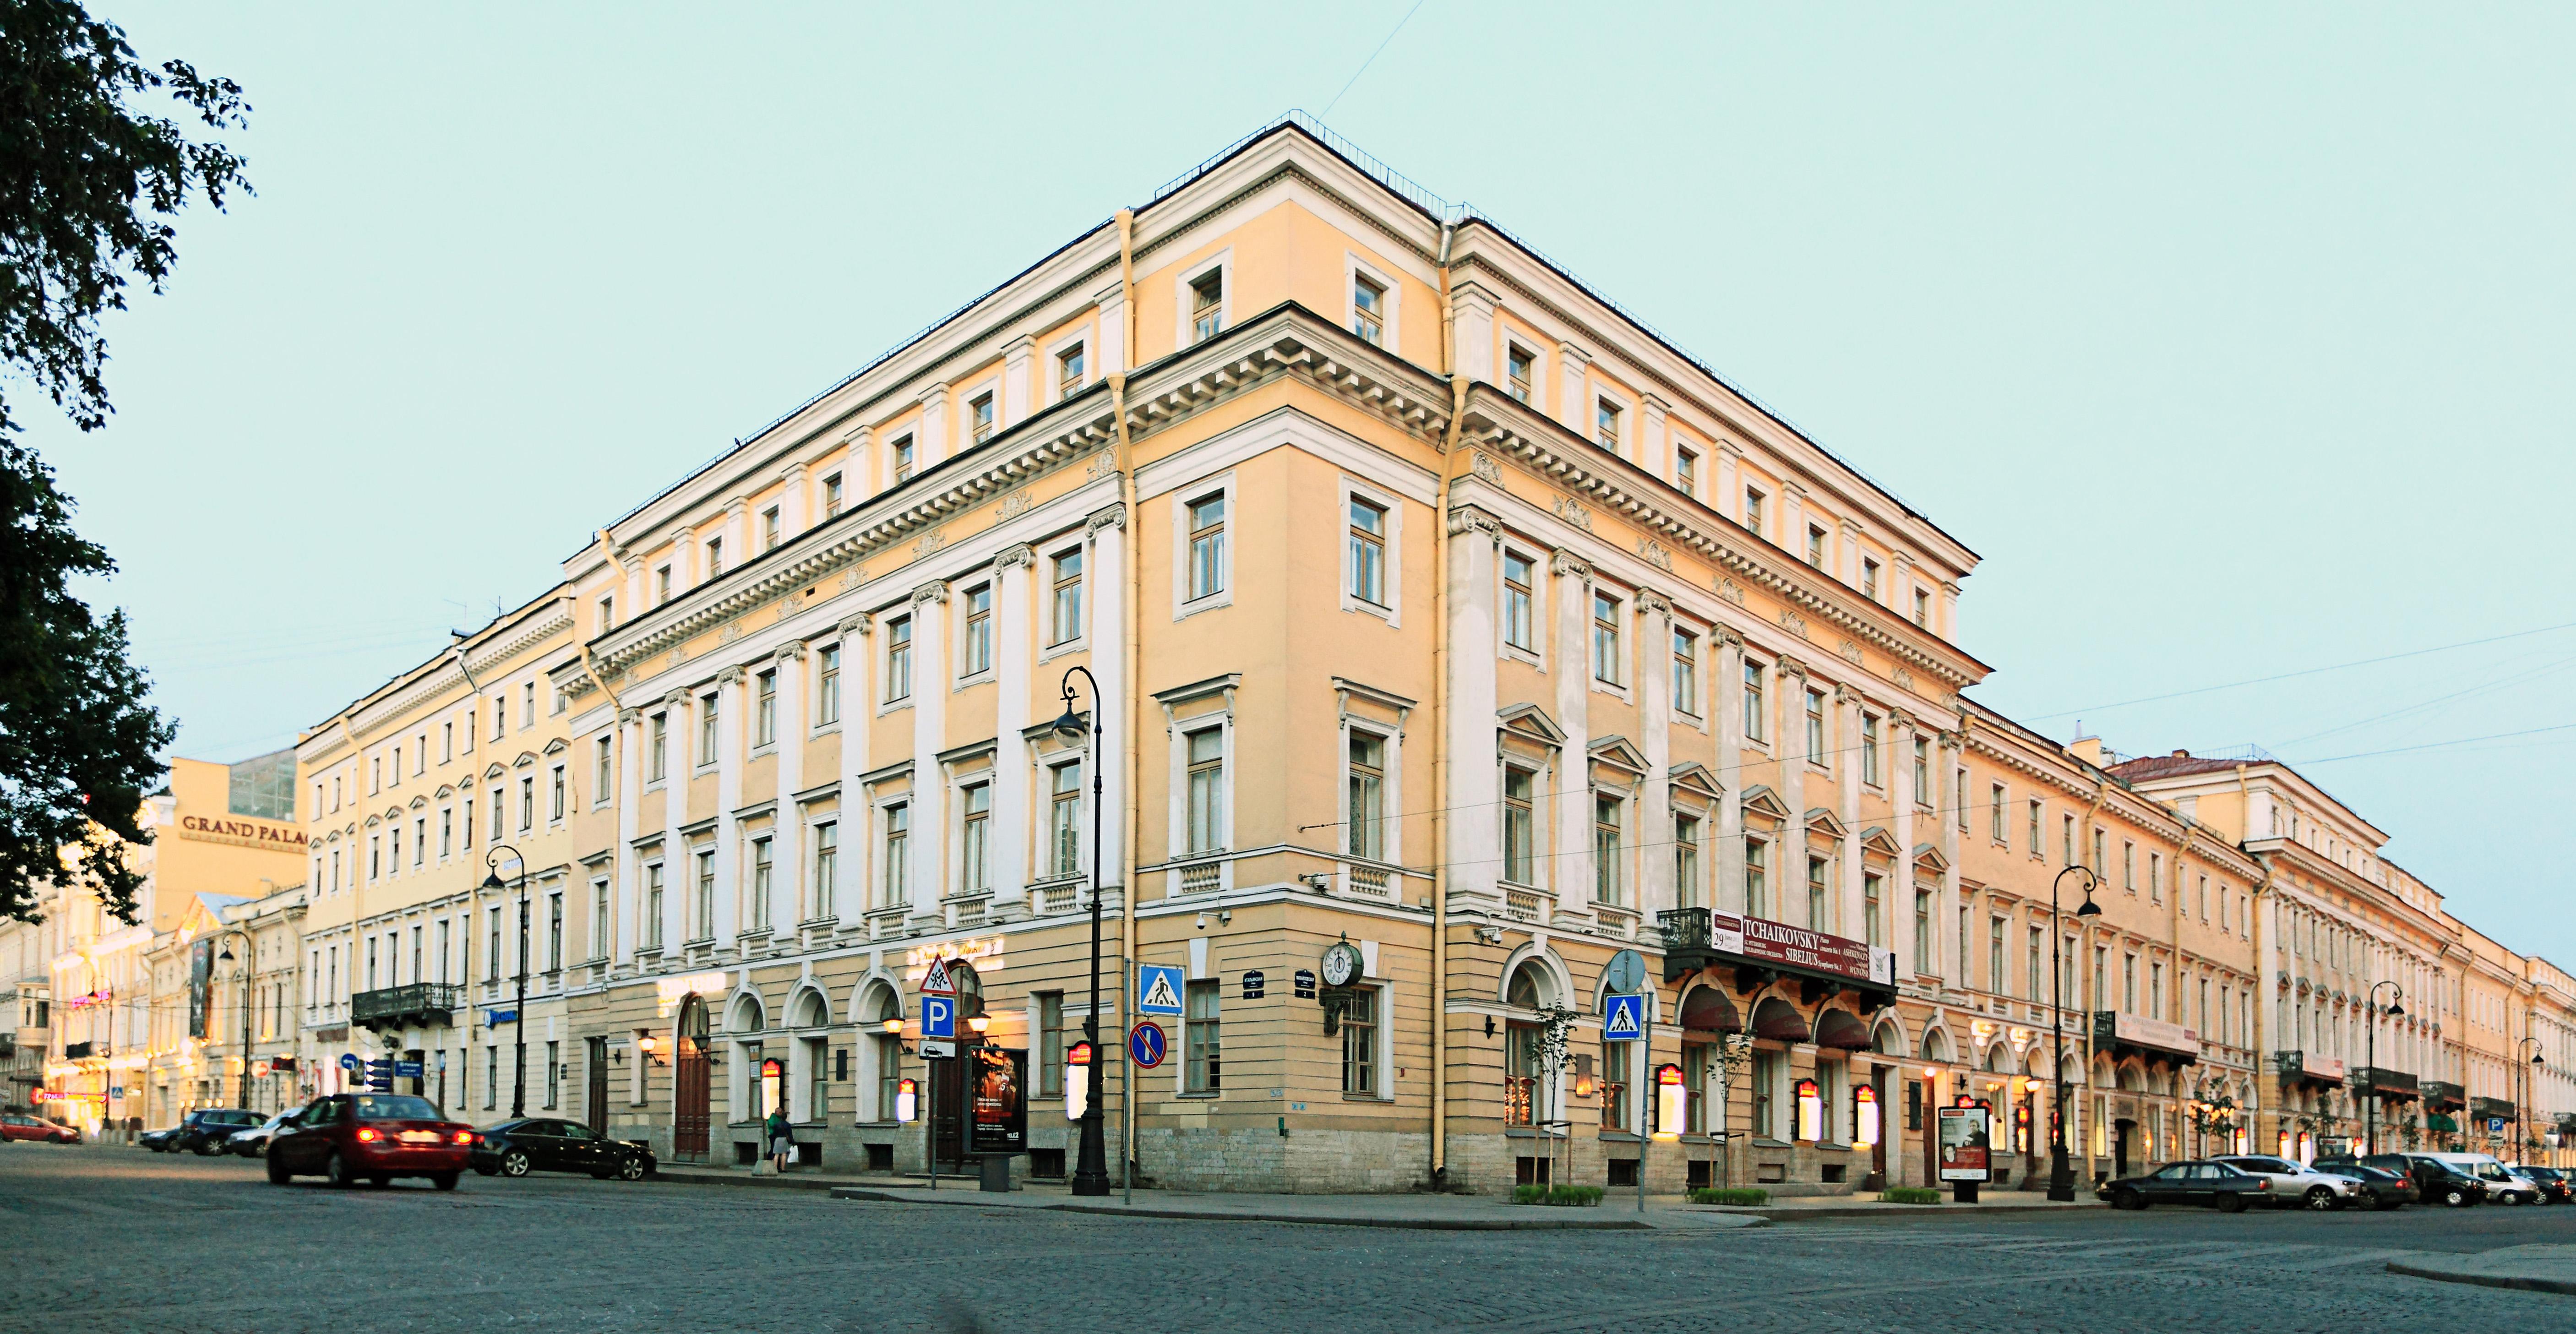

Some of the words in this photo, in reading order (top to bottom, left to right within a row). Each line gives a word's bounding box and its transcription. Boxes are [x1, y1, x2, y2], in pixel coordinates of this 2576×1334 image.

[183, 816, 253, 837] GRAND
[259, 826, 308, 844] PALA
[1714, 933, 1724, 946] 29
[1744, 919, 1819, 950] TCHAIKOVSKY
[1786, 947, 1818, 966] SIBELIUS
[930, 1002, 947, 1031] P
[2492, 1120, 2500, 1130] P
